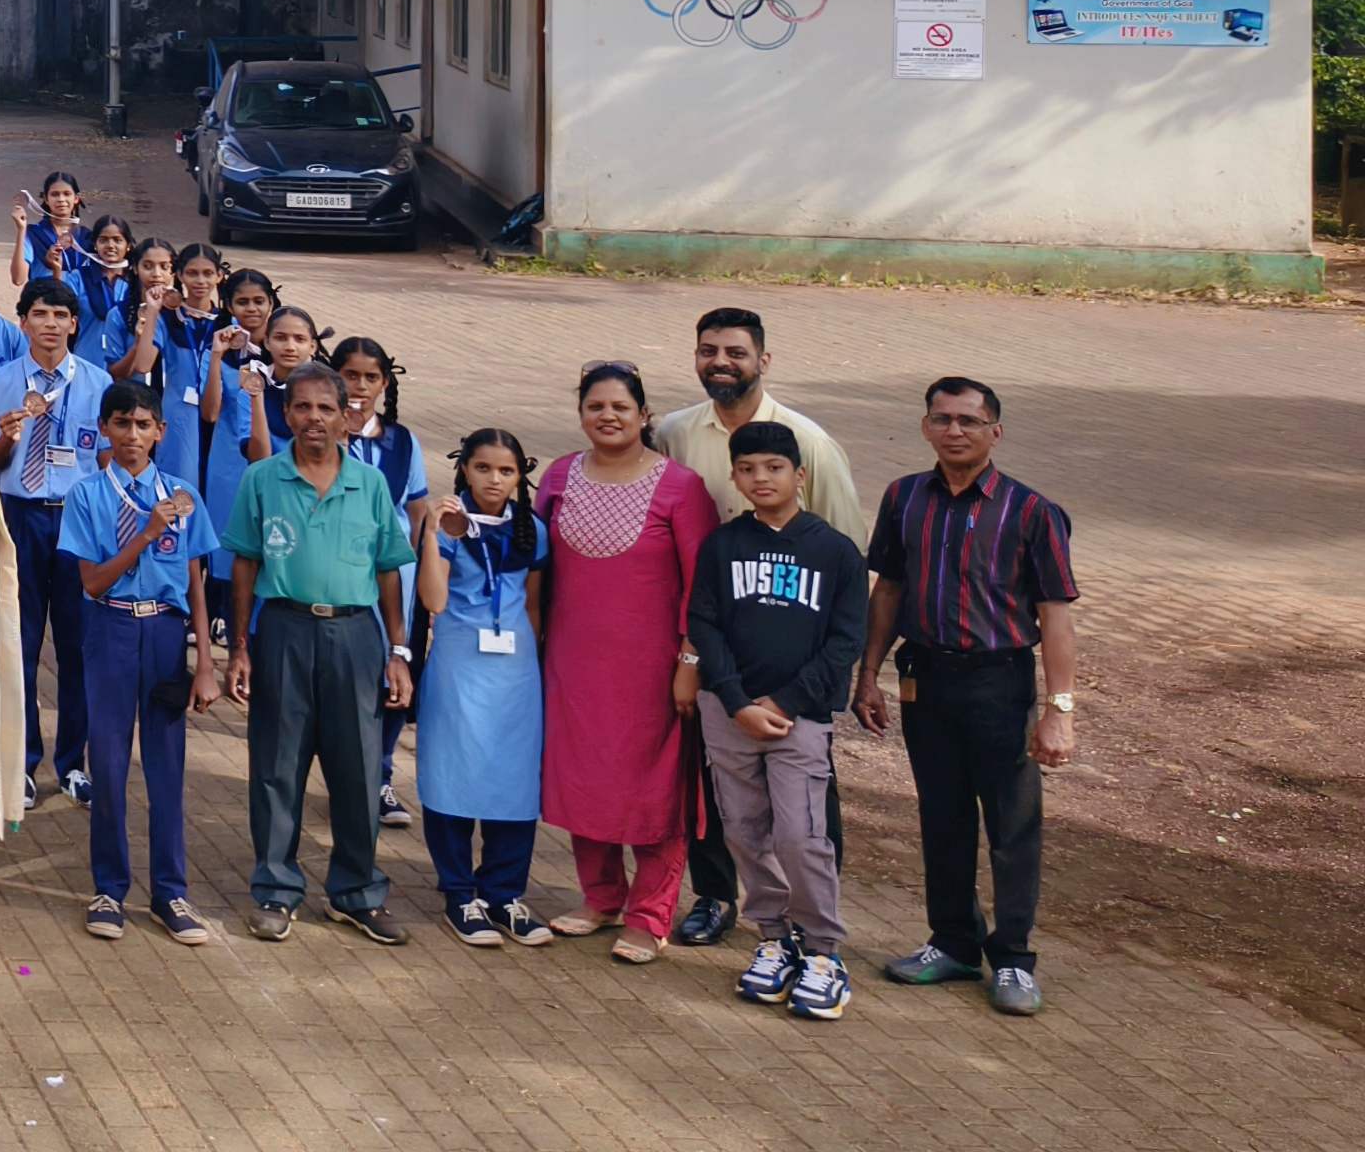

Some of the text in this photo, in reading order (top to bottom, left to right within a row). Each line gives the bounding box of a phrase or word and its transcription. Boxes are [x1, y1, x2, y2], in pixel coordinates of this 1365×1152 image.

[1101, 0, 1194, 7] Government of Goa
[1121, 26, 1173, 38] IT/ITes
